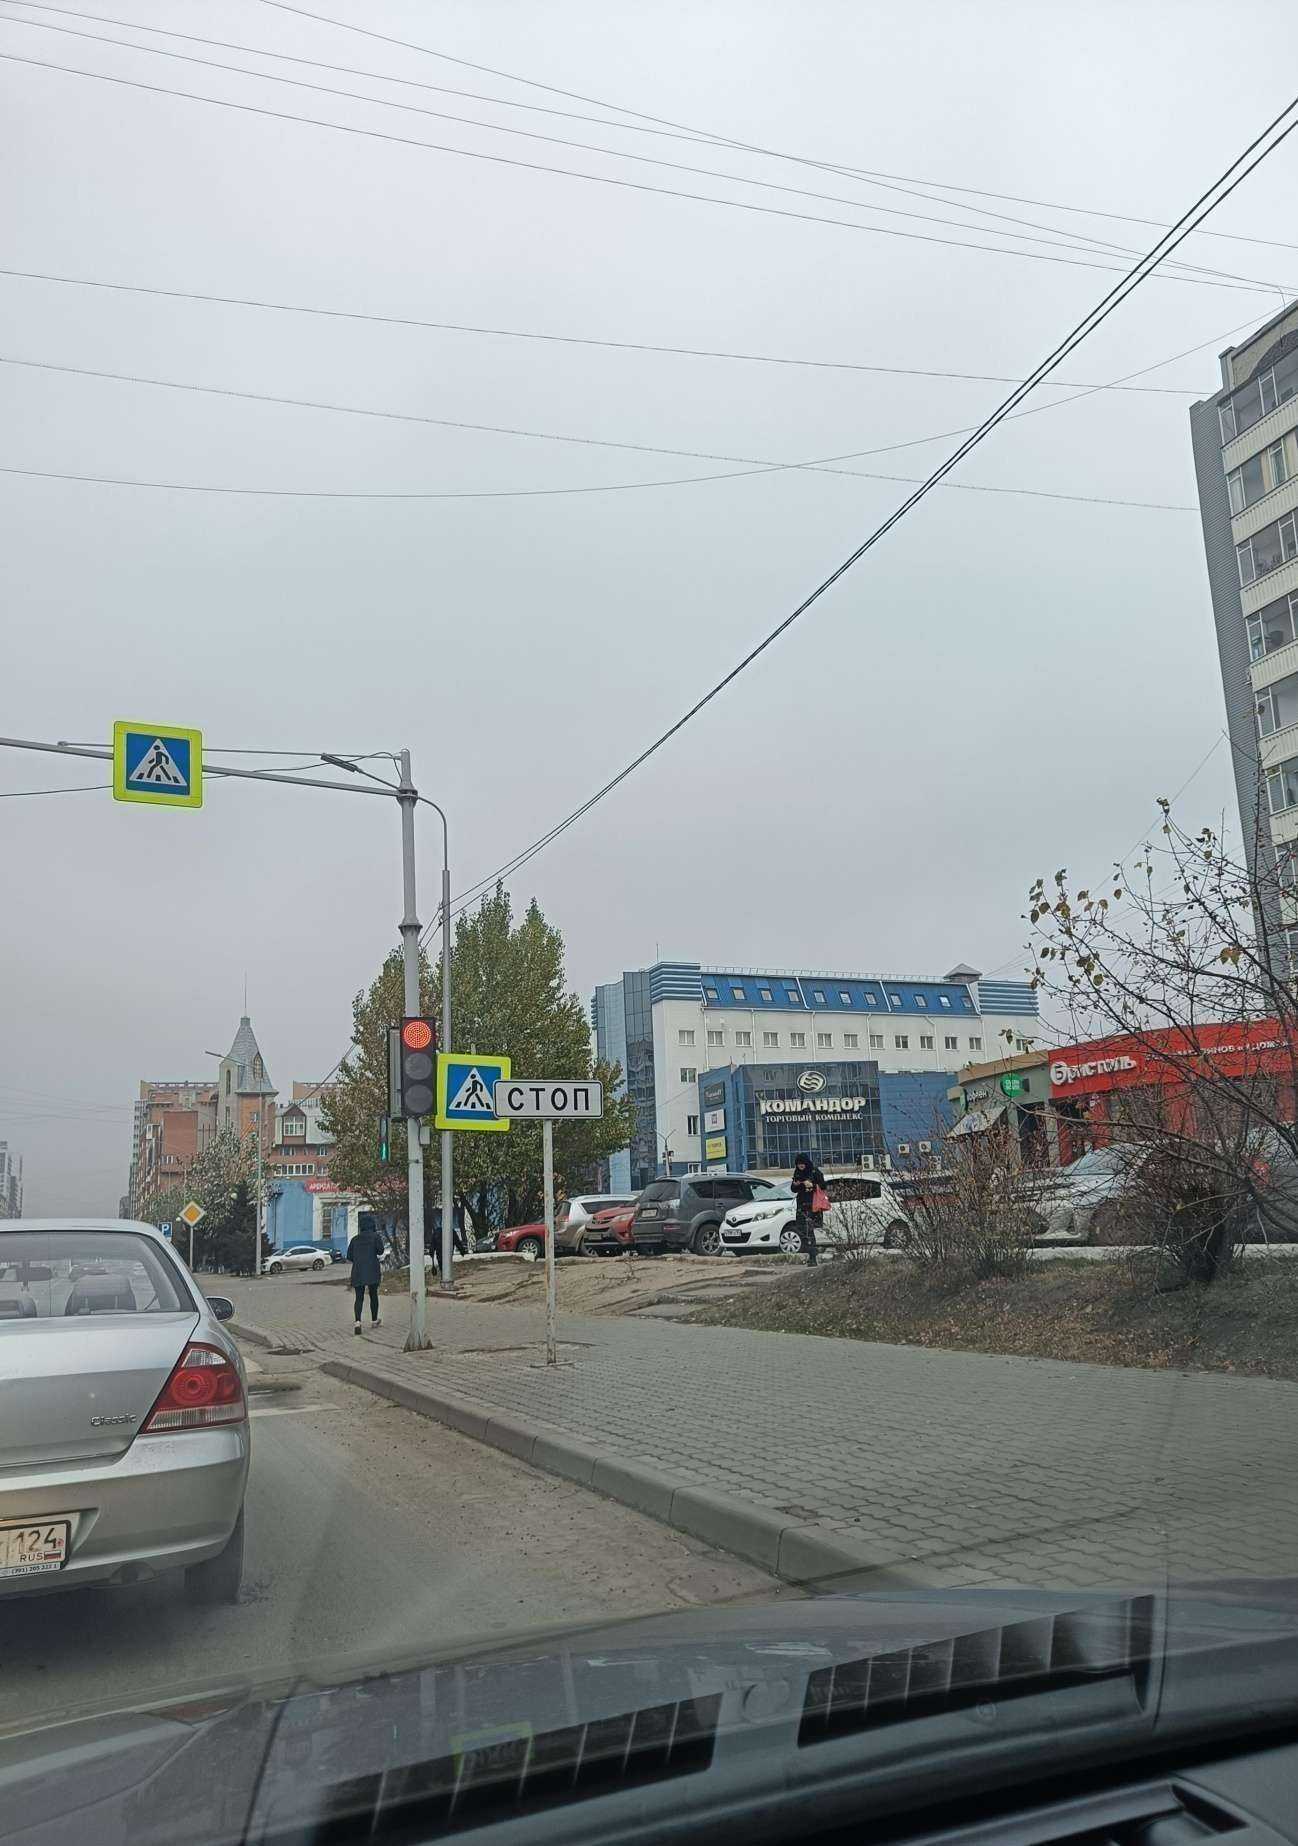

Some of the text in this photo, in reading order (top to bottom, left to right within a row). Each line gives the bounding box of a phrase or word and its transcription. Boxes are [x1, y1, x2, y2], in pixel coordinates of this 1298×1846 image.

[508, 1087, 590, 1111] СТОП
[760, 1097, 866, 1114] КОМАНДОР
[815, 1113, 864, 1121] КОМПЛЕКС
[91, 1413, 137, 1427] Classic
[15, 1528, 57, 1552] 124
[20, 1552, 43, 1562] RUS
